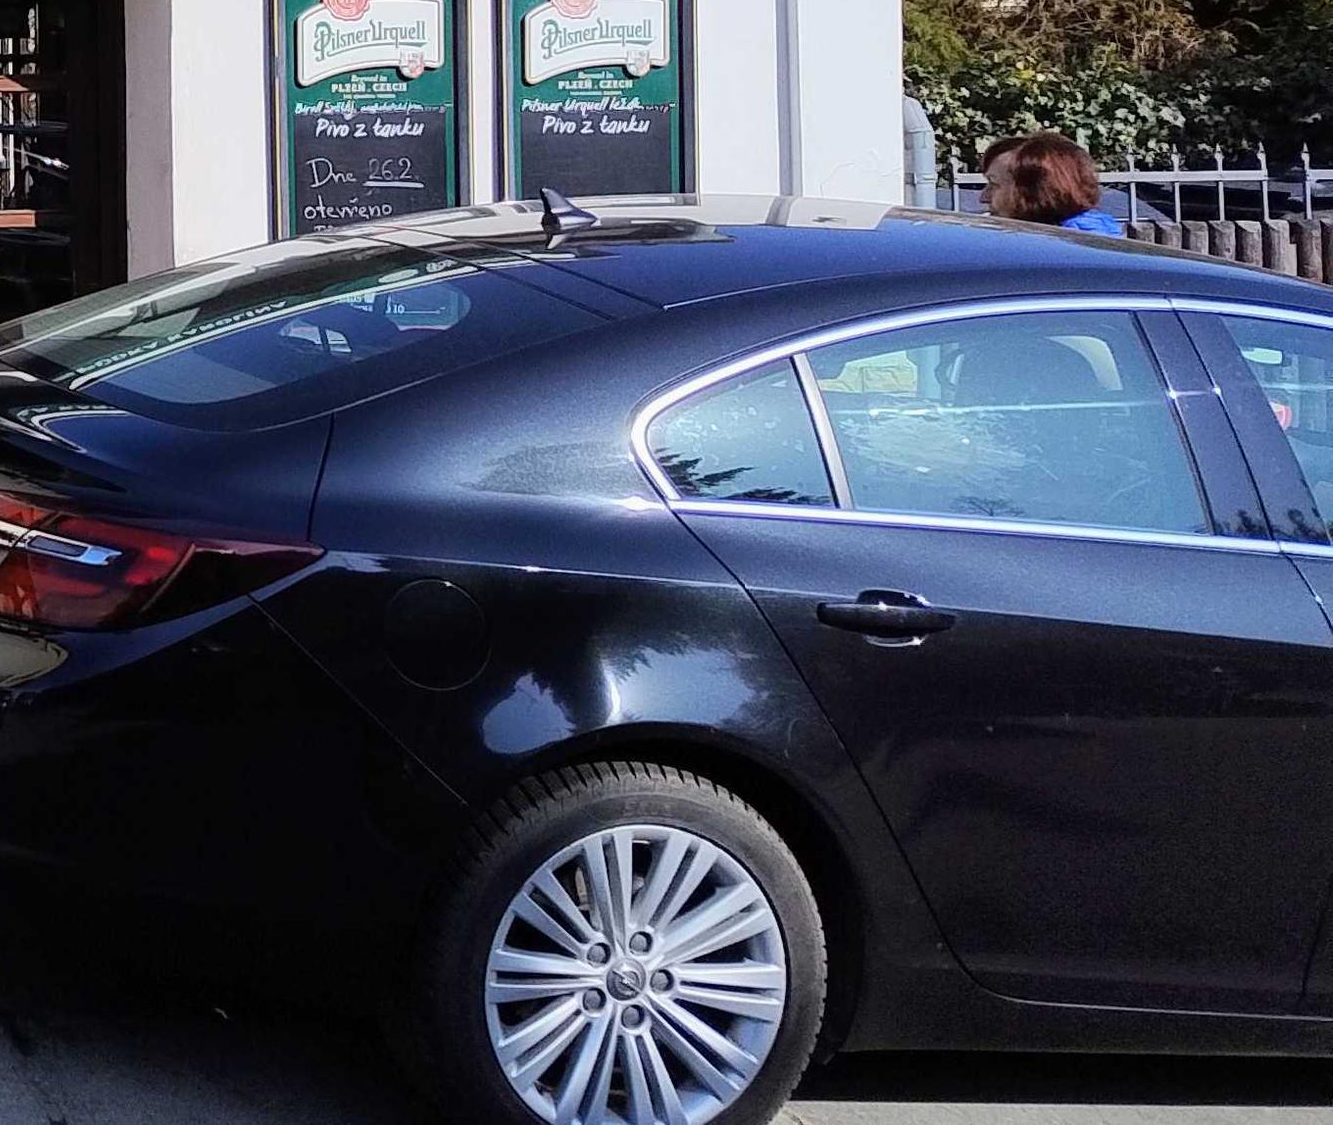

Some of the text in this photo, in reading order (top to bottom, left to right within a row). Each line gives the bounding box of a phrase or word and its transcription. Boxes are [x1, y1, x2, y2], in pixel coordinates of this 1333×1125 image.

[314, 20, 425, 62] Pilsner Urquell
[541, 18, 653, 59] Pilsner Urquell
[599, 79, 633, 89] CZECH
[316, 116, 425, 138] Pivo z tanku
[542, 114, 651, 135] Pivo z tanku
[306, 158, 357, 188] Dne
[303, 194, 393, 221] otevřeno
